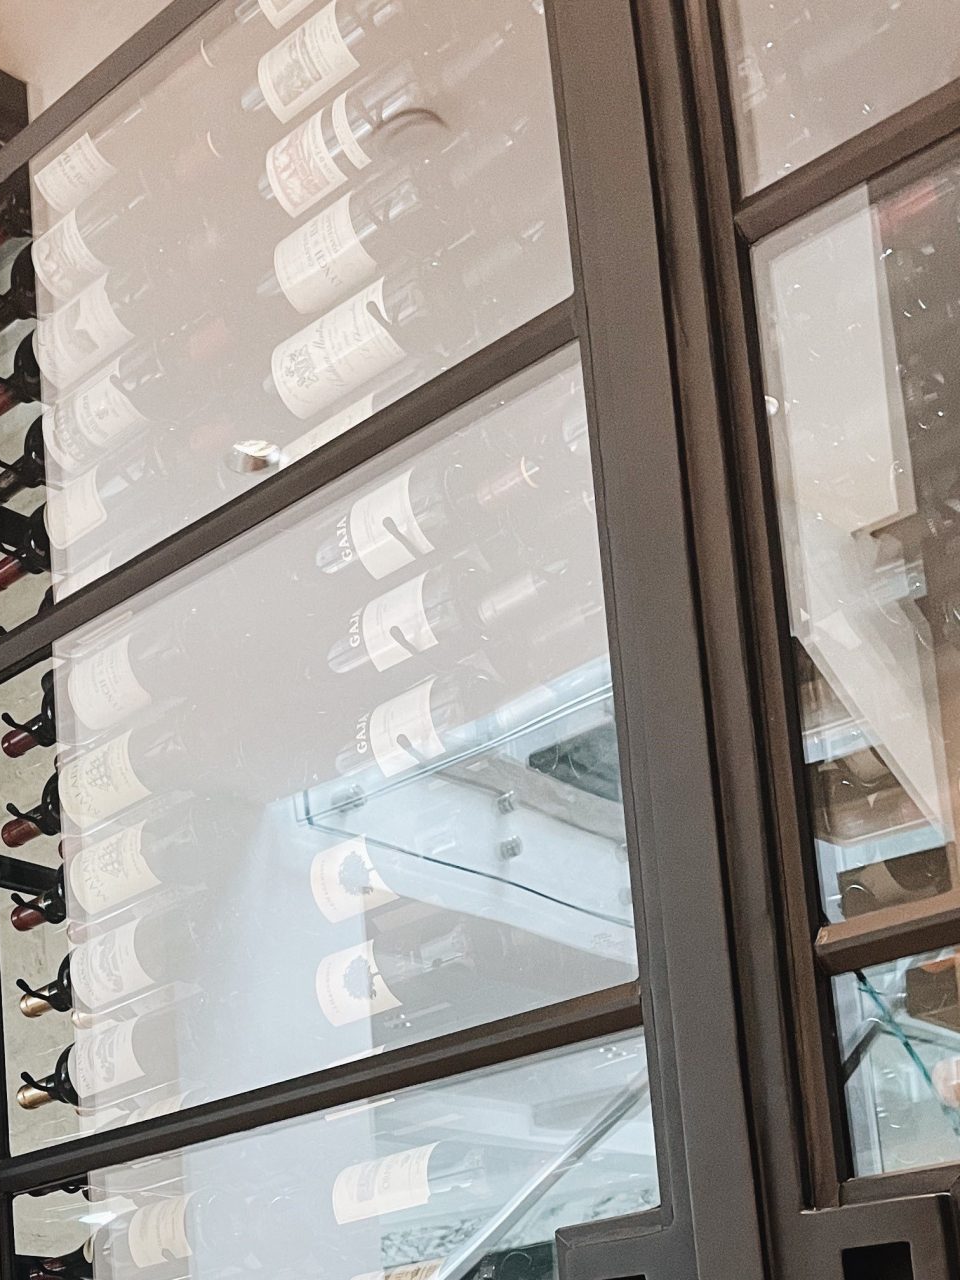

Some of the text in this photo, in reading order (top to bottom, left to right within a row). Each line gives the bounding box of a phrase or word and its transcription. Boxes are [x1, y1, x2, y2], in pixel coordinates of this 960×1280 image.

[336, 516, 354, 562] GAJA
[349, 608, 364, 648] GAJA
[355, 711, 370, 754] GAJA
